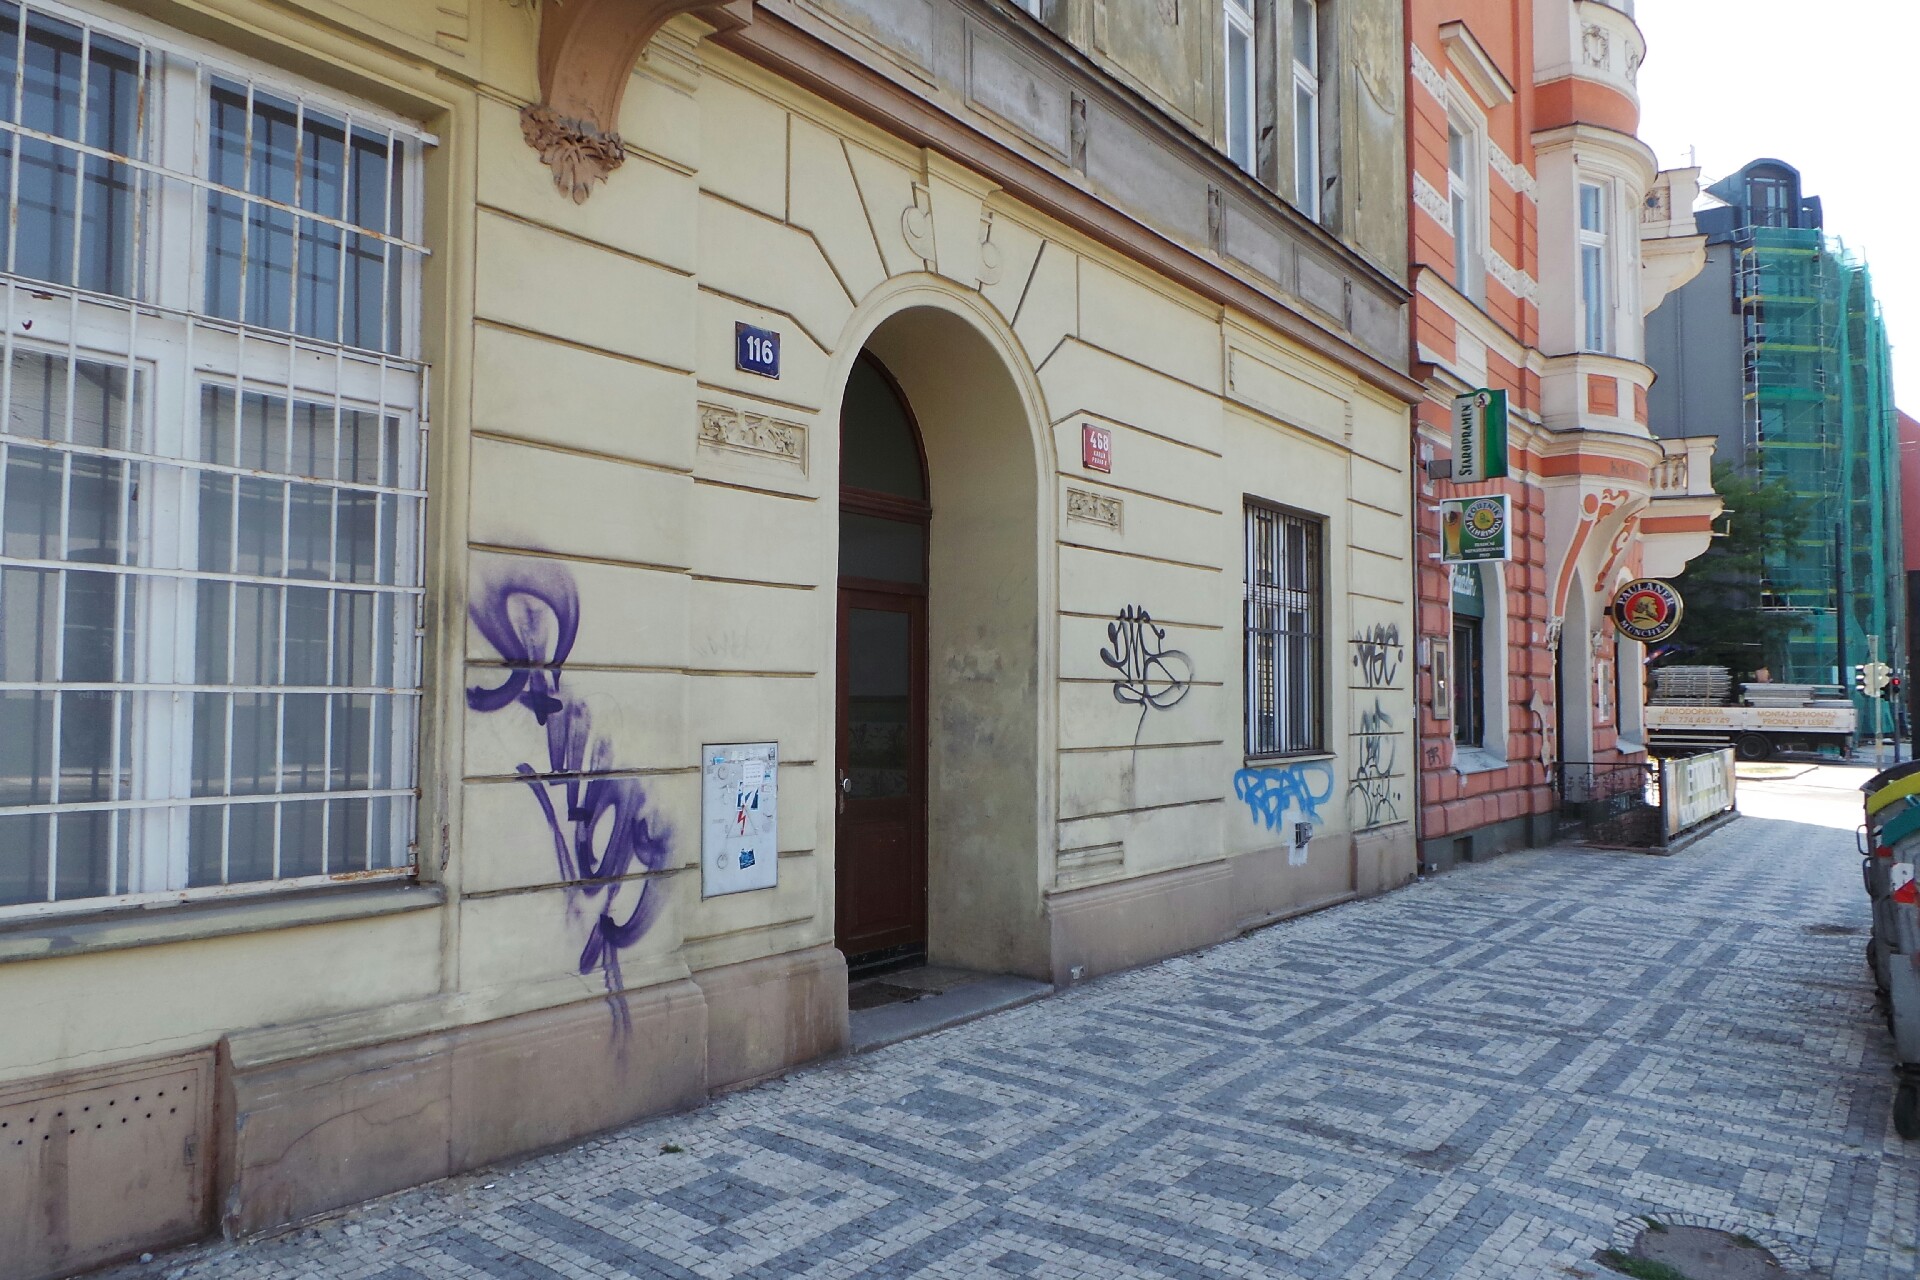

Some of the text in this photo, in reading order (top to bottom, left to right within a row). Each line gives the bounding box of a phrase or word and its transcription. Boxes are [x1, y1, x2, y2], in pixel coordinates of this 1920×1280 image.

[747, 335, 774, 364] 116
[1090, 430, 1109, 451] 468
[1616, 582, 1675, 605] PAULANER
